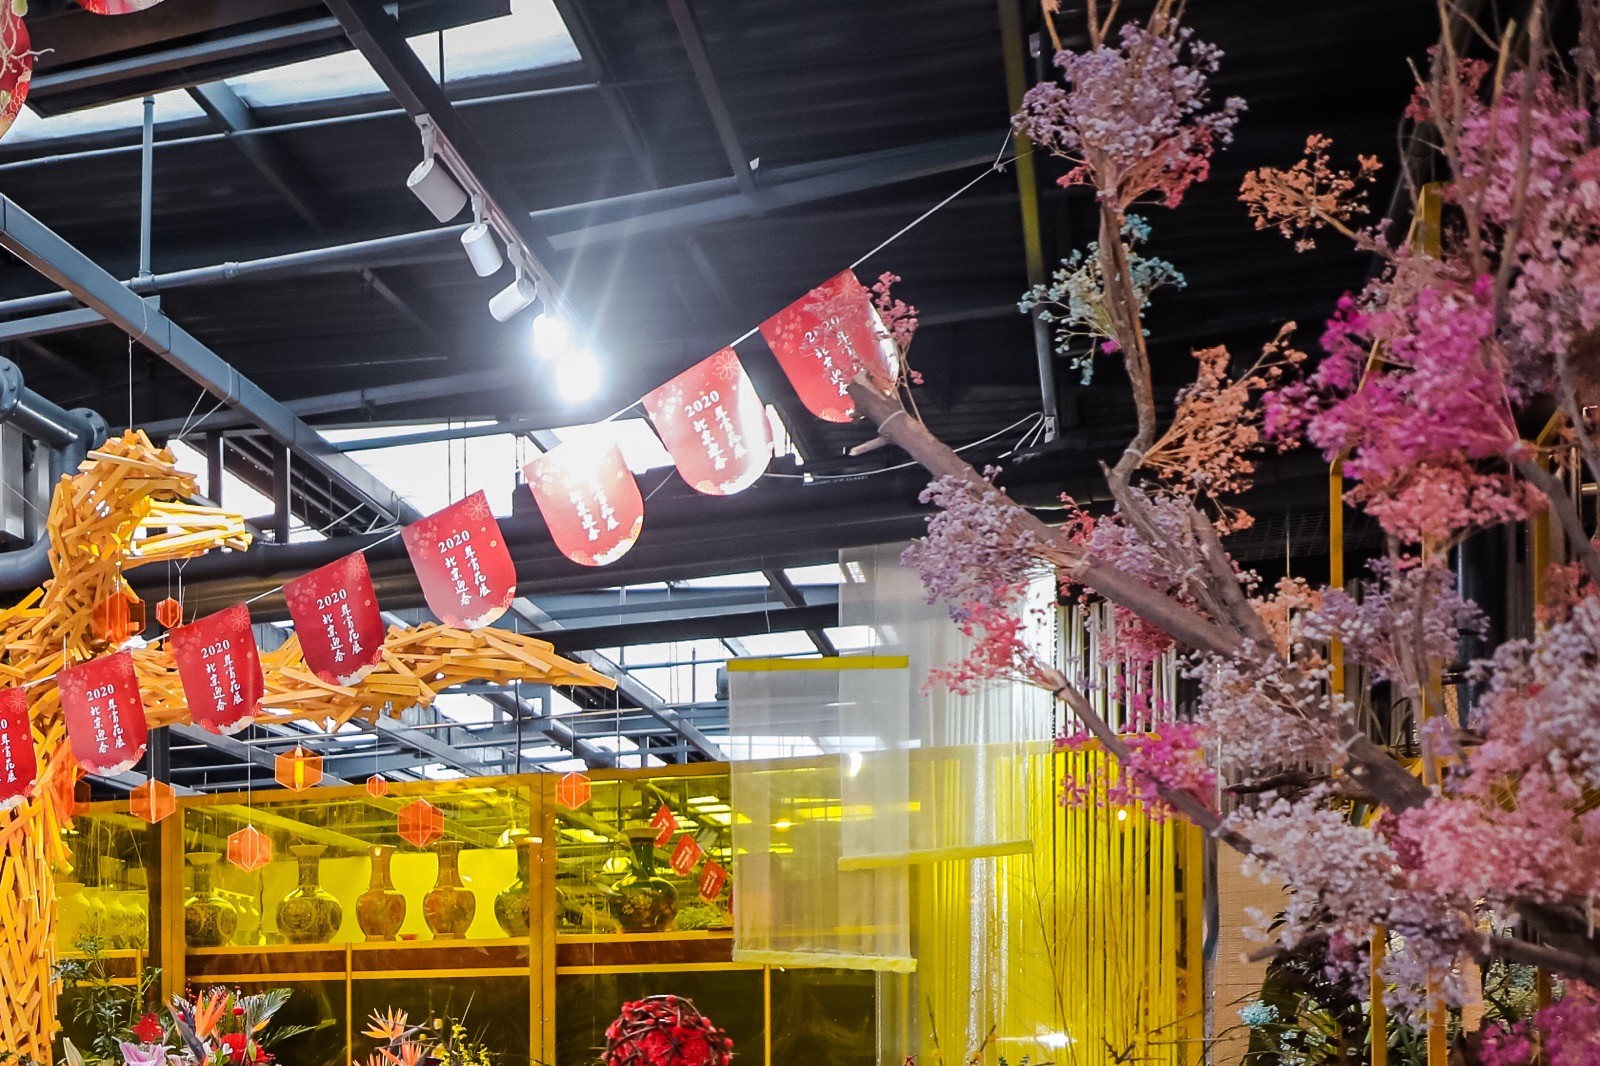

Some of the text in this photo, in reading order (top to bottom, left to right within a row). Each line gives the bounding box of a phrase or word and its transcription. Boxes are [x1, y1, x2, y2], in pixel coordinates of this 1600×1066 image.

[804, 315, 840, 343] 220
[684, 390, 720, 418] 2020
[437, 529, 471, 554] 2020
[444, 555, 473, 606] 北京迎春
[464, 544, 491, 598] 年宵花展
[316, 588, 347, 610] 2020
[201, 639, 231, 658] 2020
[321, 613, 346, 663] 北京迎春
[340, 603, 364, 654] 年宵花展
[86, 683, 115, 702] 2020
[205, 662, 227, 711] 北京迎春
[223, 653, 244, 705] 年宵花展
[89, 704, 109, 753] 北京迎春
[107, 698, 126, 748] 年宵花展
[0, 733, 18, 783] 年宵花展
